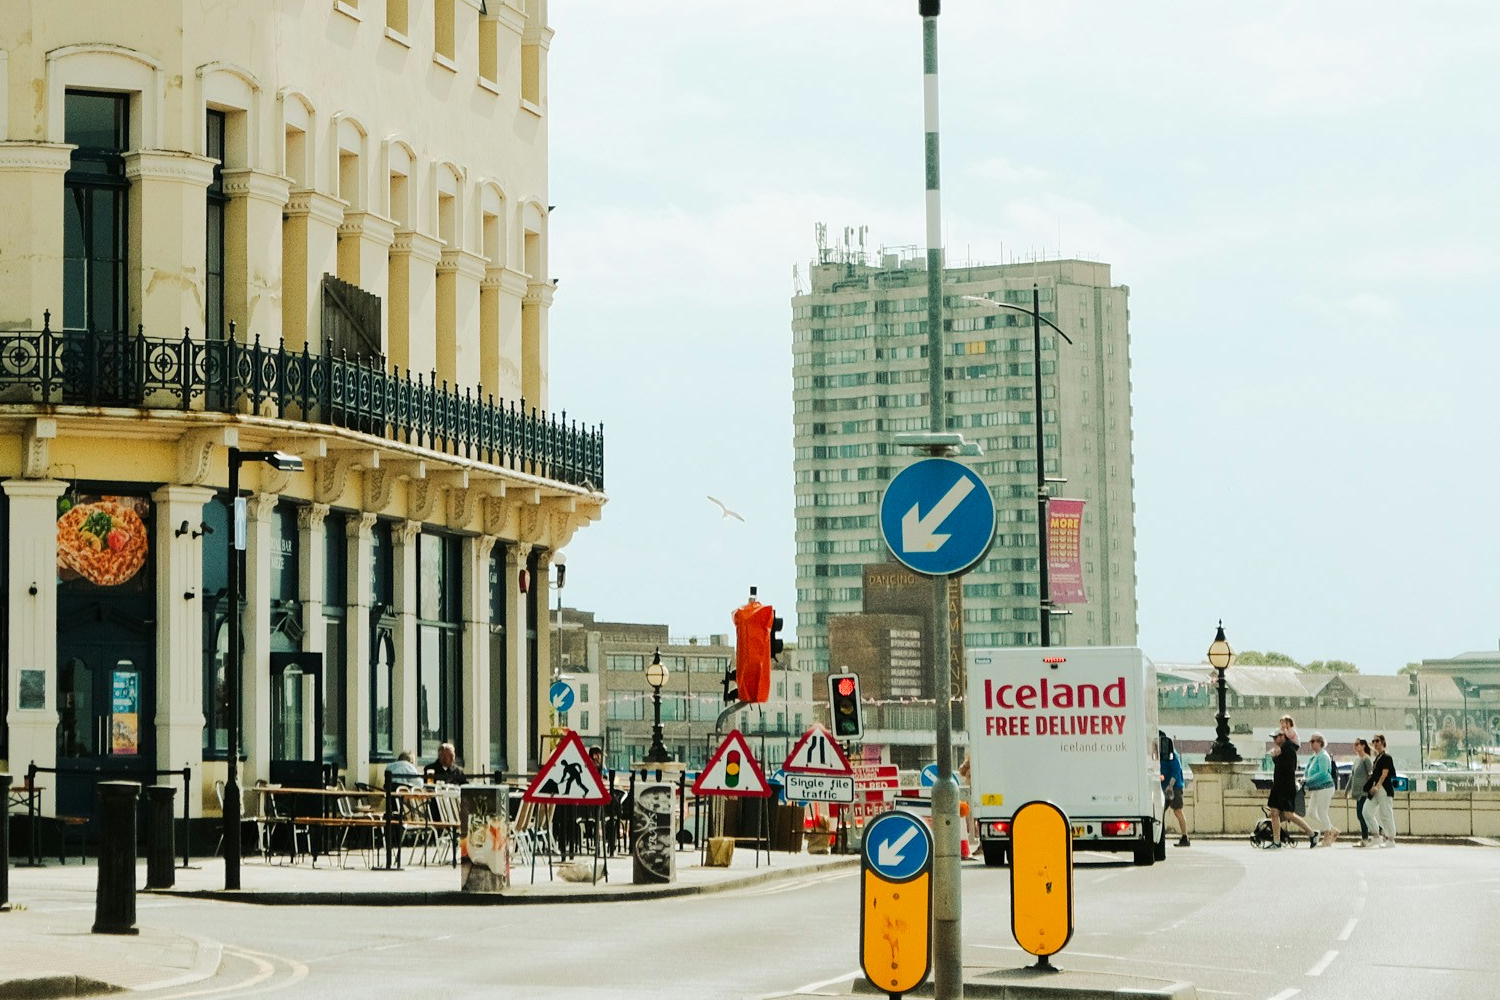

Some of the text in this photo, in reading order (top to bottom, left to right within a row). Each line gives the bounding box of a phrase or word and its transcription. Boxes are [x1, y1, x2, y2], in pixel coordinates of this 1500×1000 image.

[1050, 518, 1079, 529] MORE
[282, 539, 292, 552] BAR
[869, 575, 915, 584] DANCING
[949, 577, 960, 697] EAMLAND
[984, 677, 1126, 709] Iceland
[986, 715, 1126, 736] FREE DELIVERY
[1060, 741, 1127, 752] iceland.co.uk
[790, 777, 849, 791] Single file
[869, 781, 888, 790] RED
[802, 789, 837, 800] traffic
